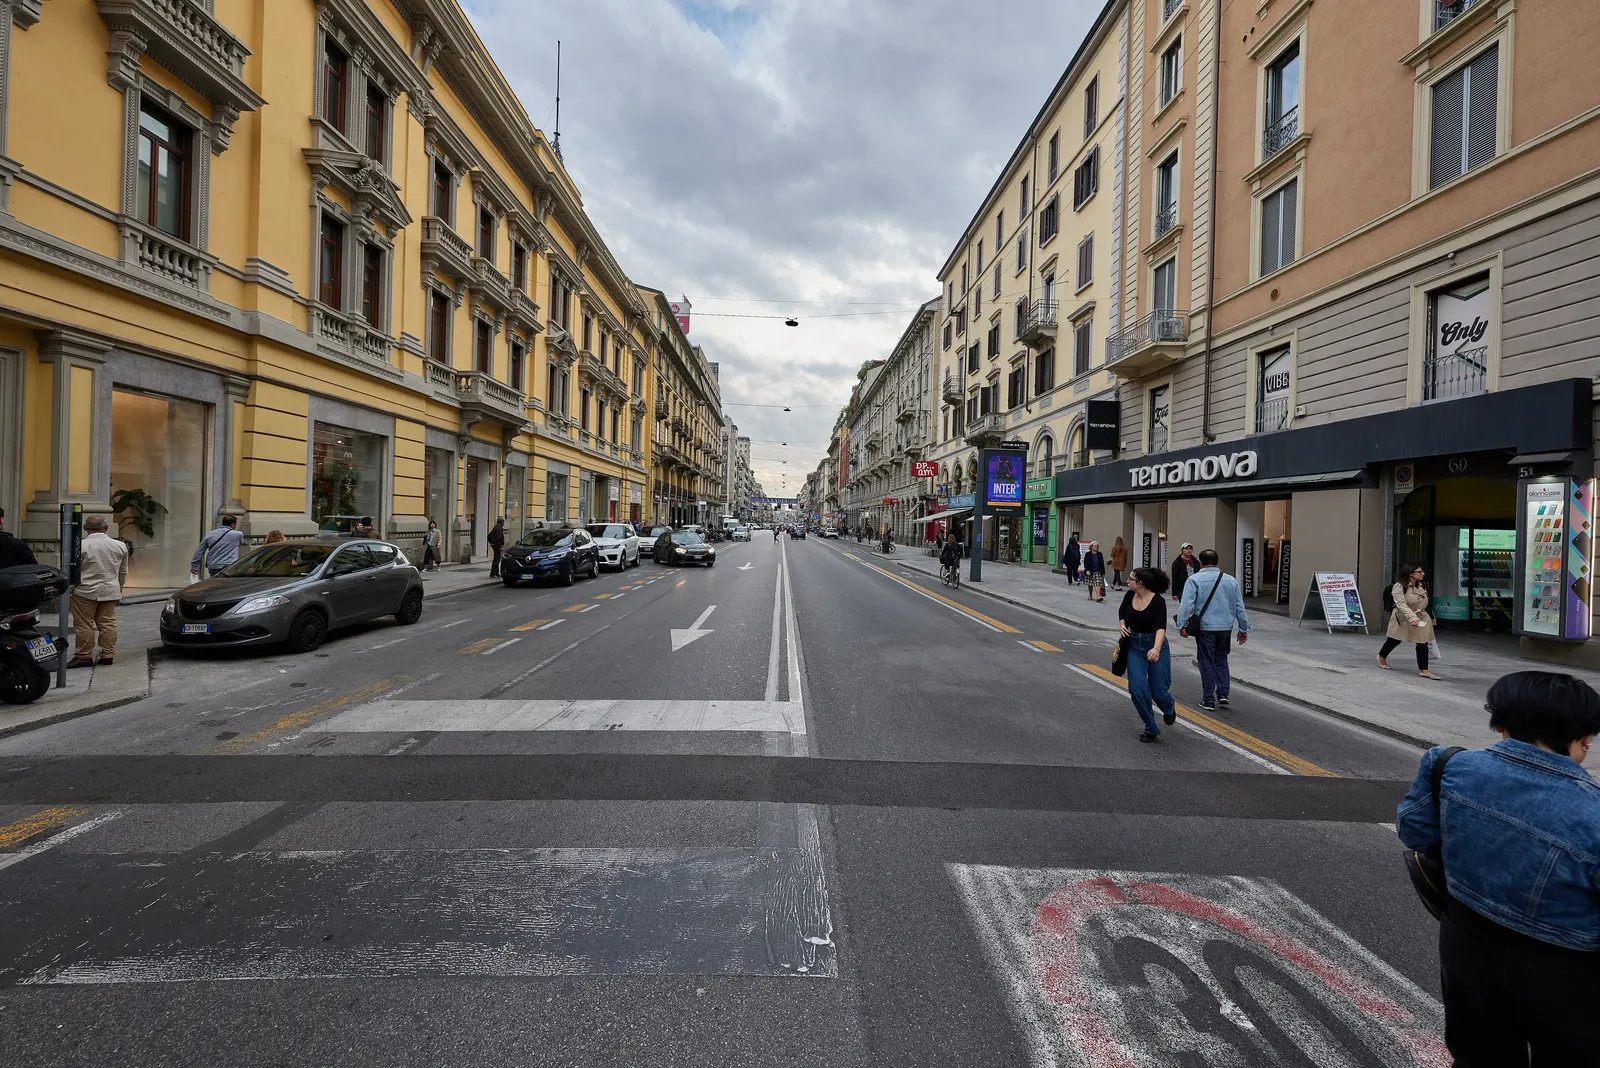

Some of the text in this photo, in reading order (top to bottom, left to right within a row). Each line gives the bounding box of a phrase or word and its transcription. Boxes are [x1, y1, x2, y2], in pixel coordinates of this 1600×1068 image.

[1441, 316, 1489, 347] Only
[1520, 466, 1533, 478] 51
[993, 483, 1016, 494] INTER
[1528, 490, 1561, 498] glamcase
[32, 638, 41, 648] EP
[34, 645, 55, 657] 44381
